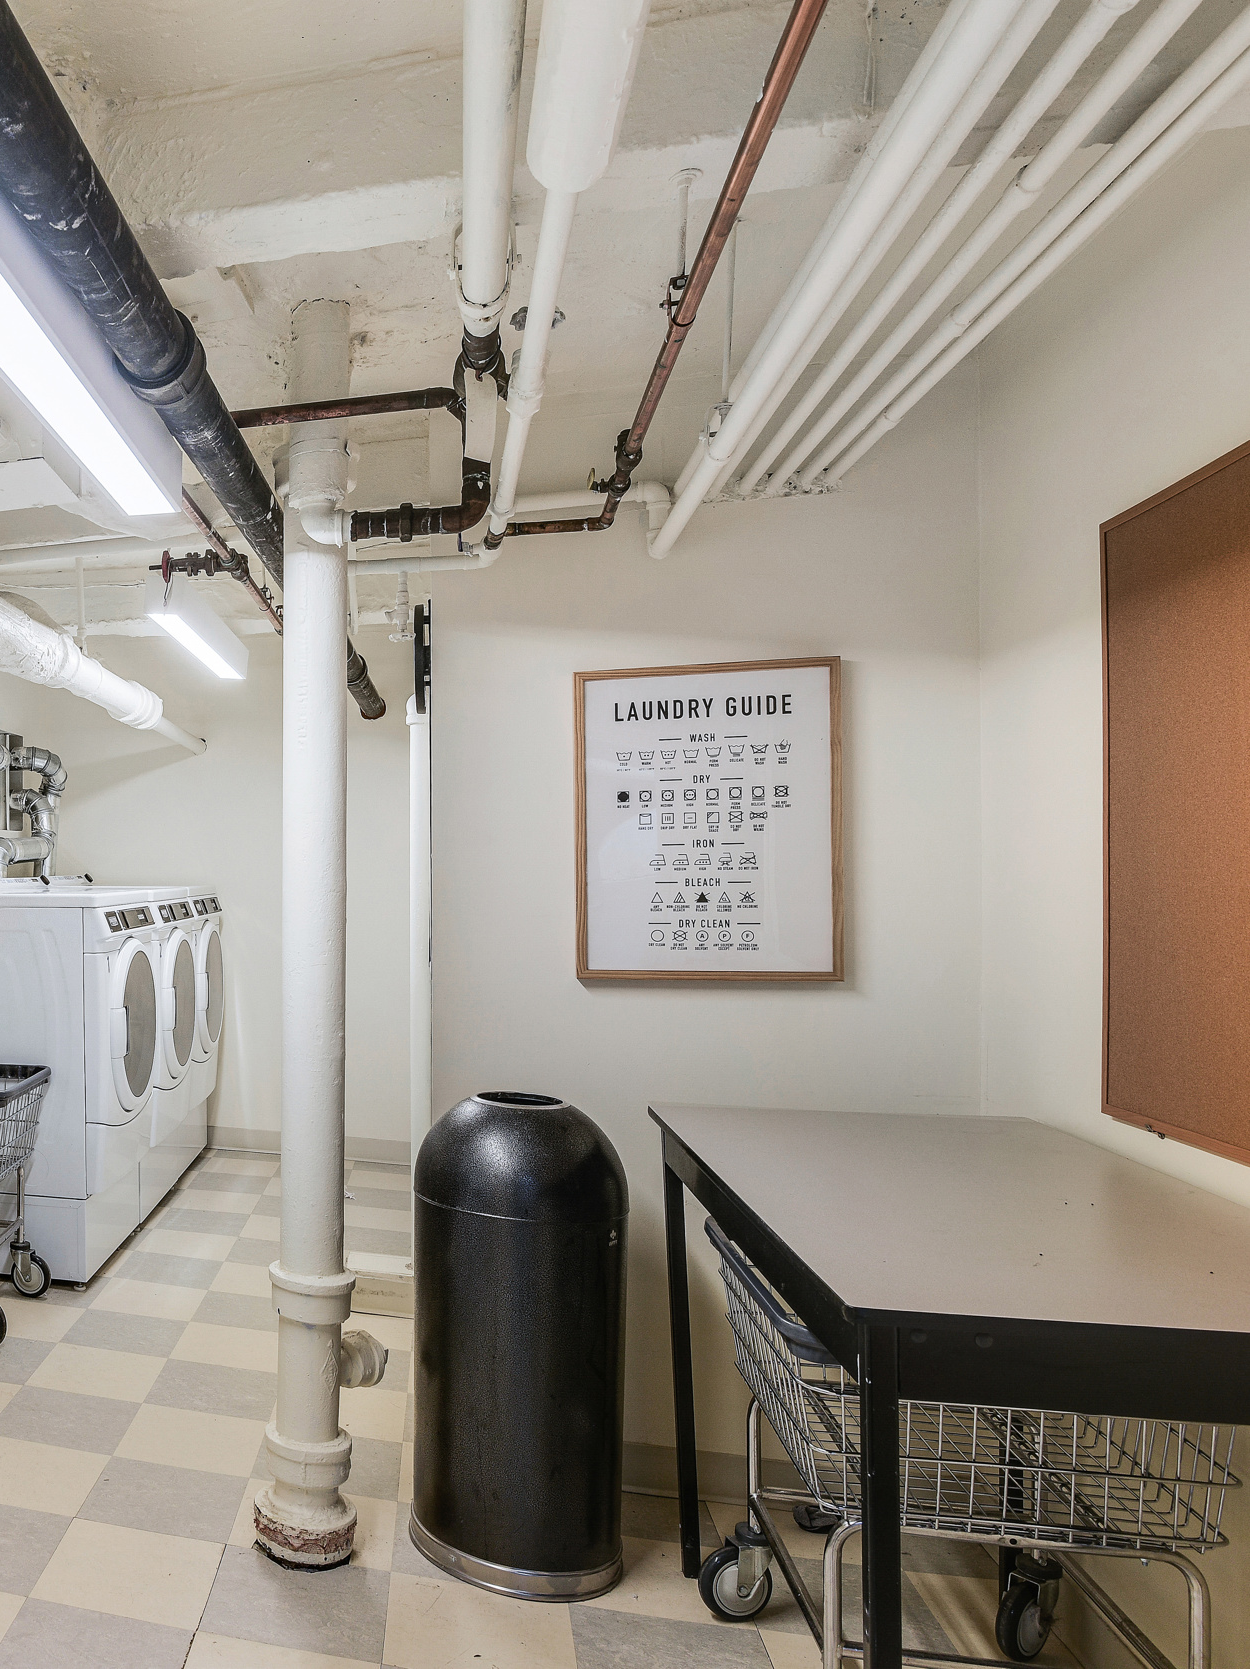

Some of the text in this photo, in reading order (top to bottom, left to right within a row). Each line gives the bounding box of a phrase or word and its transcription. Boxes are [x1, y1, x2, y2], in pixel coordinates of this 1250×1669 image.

[614, 694, 792, 722] LAUNDRY GUIDE
[690, 733, 716, 742] WASH
[692, 774, 712, 784] DRY
[692, 839, 716, 848] IRON
[685, 878, 721, 887] BLEACH
[678, 919, 730, 928] DRY CLEAN
